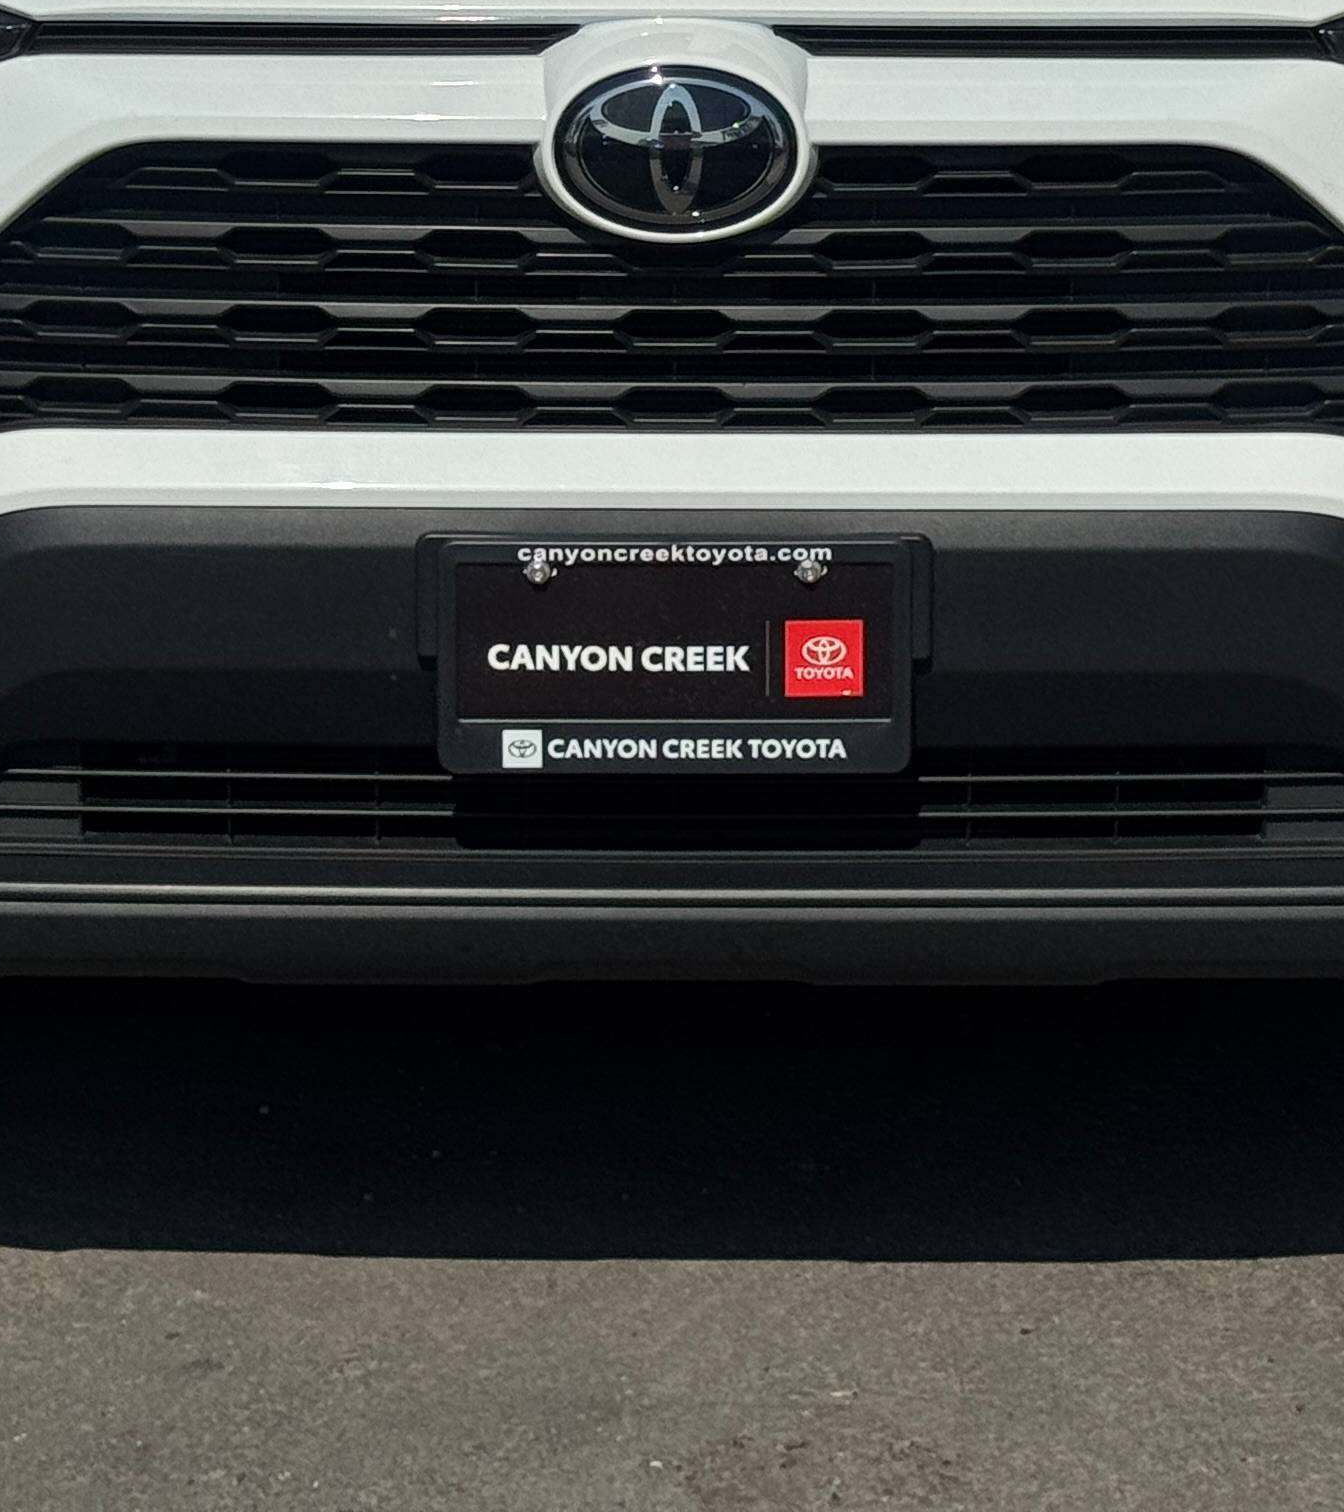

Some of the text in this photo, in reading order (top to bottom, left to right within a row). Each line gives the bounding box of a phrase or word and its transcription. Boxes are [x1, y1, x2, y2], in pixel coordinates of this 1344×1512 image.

[517, 544, 832, 566] canyoncreektoyota.com
[487, 643, 750, 673] CANYON CREEK
[794, 667, 854, 680] TOYOTA
[547, 738, 847, 760] CANYON CREEK TOYOTA
